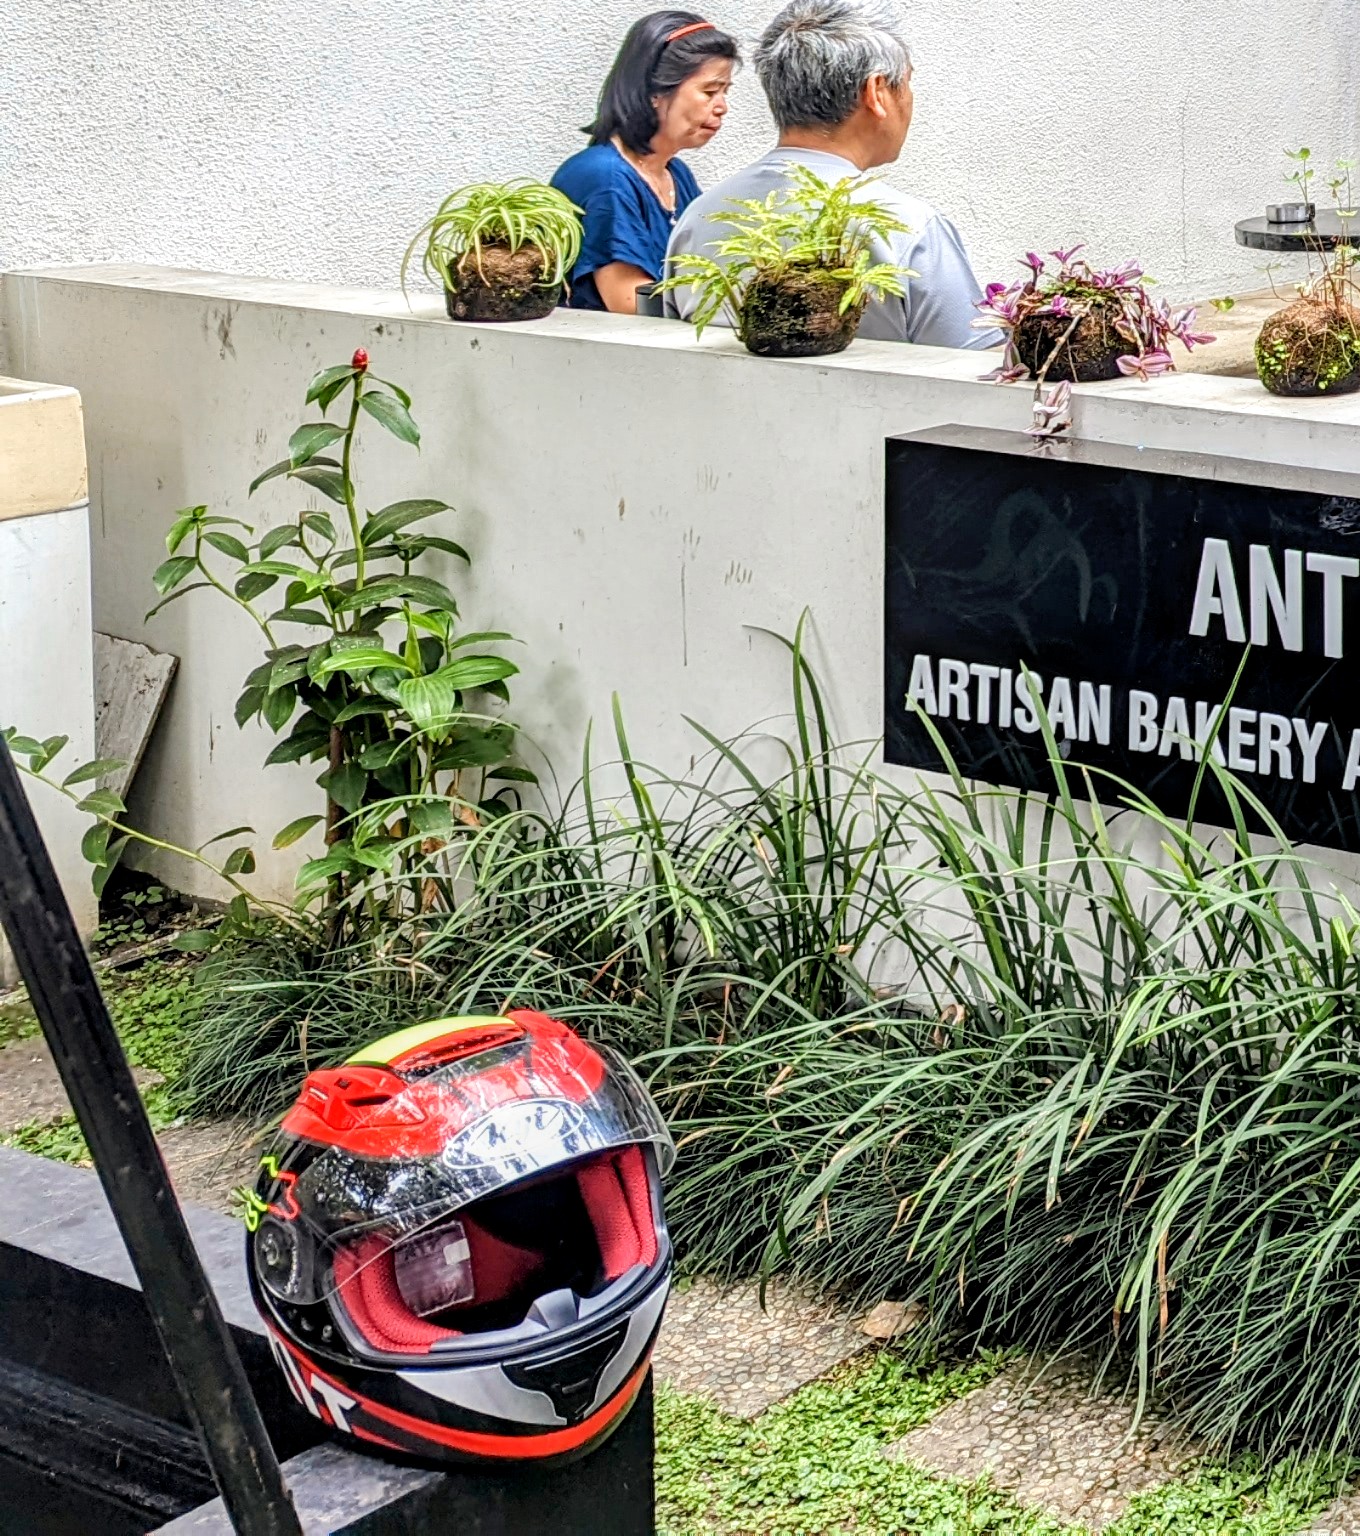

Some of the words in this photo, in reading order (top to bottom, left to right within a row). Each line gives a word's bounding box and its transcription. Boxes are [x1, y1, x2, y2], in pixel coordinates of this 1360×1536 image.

[1189, 537, 1360, 659] ANT
[905, 654, 1111, 746] ARTISAN
[1128, 689, 1329, 784] BAKERY
